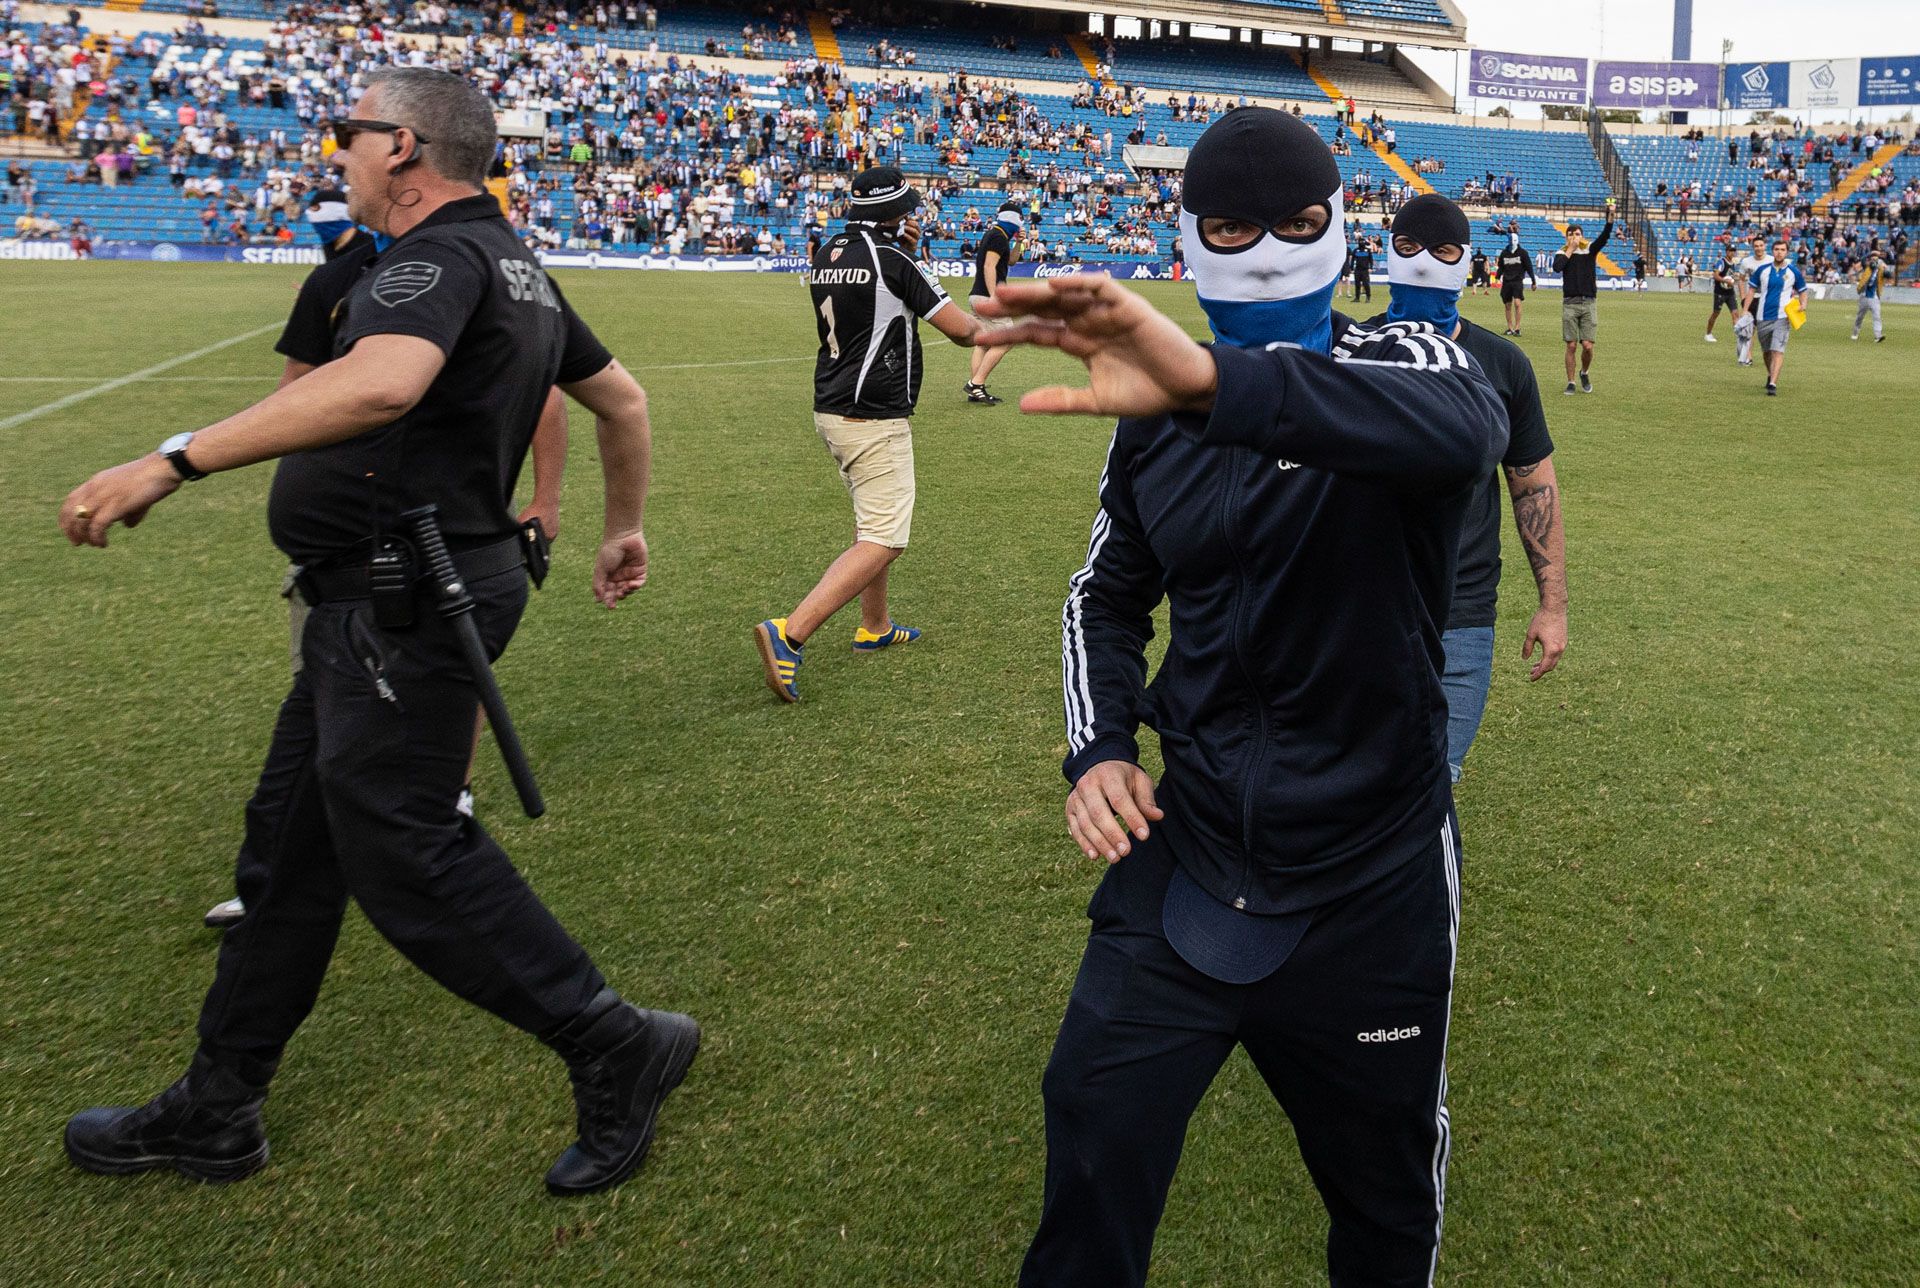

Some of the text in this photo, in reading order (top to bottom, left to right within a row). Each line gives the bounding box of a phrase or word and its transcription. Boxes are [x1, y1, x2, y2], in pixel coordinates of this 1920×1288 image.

[1501, 62, 1578, 82] SCANIA
[1477, 85, 1578, 101] SCALEVANTE
[1609, 75, 1682, 96] asisa
[868, 185, 895, 196] ellesse
[811, 268, 871, 284] LATAYUD
[819, 295, 840, 360] 1
[1357, 1025, 1421, 1043] adidas
